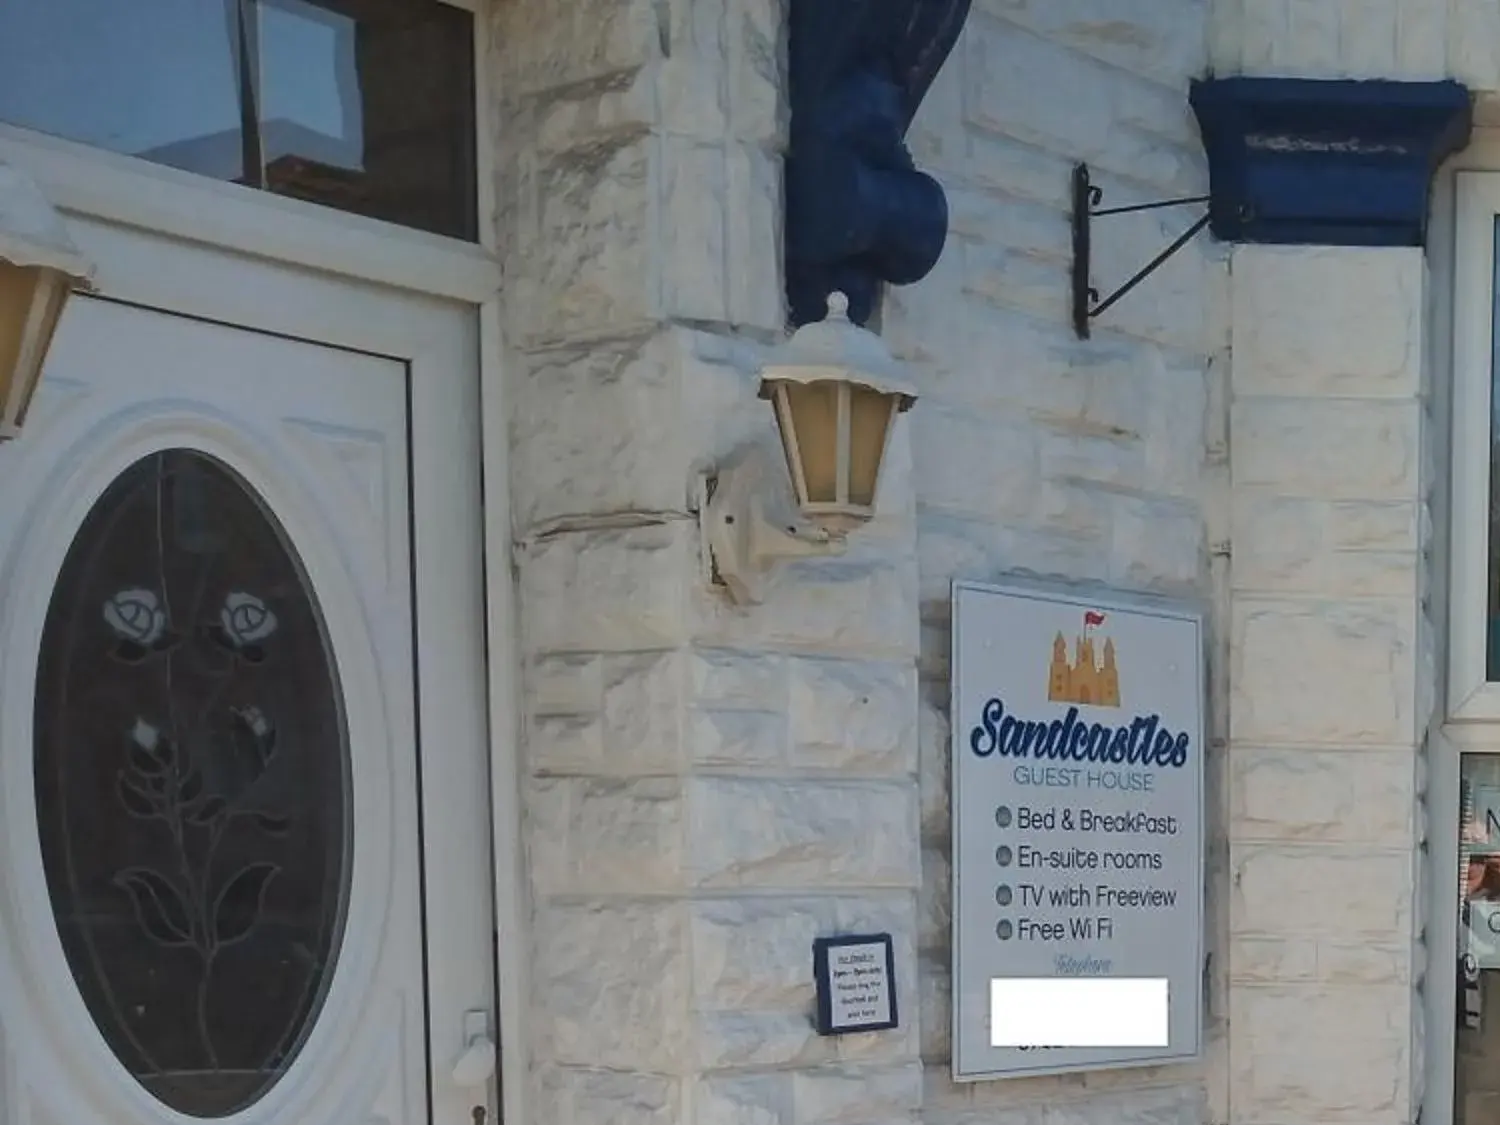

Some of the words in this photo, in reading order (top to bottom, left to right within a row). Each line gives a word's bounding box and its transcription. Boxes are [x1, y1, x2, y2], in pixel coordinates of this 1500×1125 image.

[970, 698, 1190, 767] Sandcastles
[1013, 766, 1081, 787] GUEST
[1087, 770, 1154, 791] HOUSE
[1017, 806, 1055, 830] Bed
[1061, 808, 1075, 831] &
[1080, 808, 1177, 835] Breakfast
[1018, 845, 1098, 869] En-suite
[1103, 852, 1163, 870] rooms
[1018, 884, 1044, 908] TV
[1049, 884, 1091, 907] with
[1096, 884, 1178, 908] Freeview
[1018, 917, 1065, 941] Free
[1069, 917, 1091, 940] Wi
[1096, 917, 1113, 940] Fi
